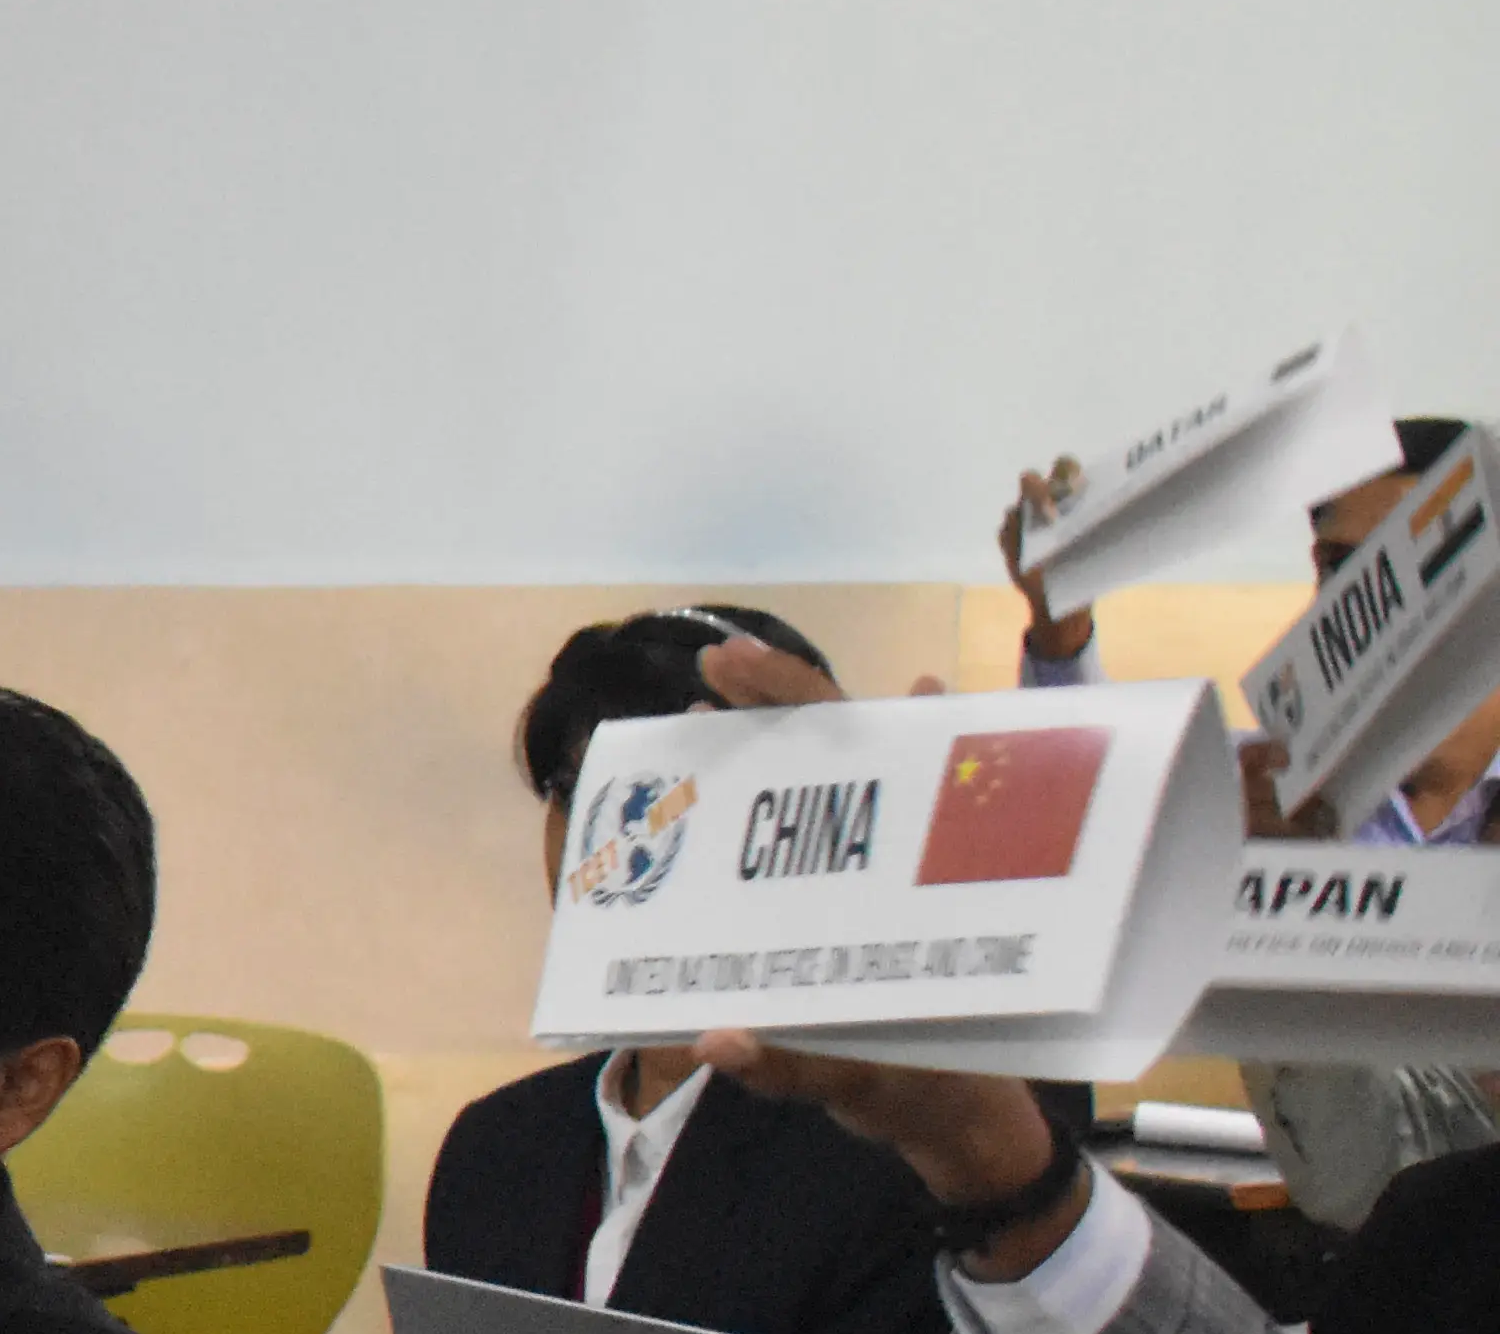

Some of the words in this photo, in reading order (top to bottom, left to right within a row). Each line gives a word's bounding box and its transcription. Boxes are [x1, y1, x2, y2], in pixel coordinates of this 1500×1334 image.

[1307, 544, 1406, 695] INDIA
[738, 778, 881, 882] CHINA
[1235, 869, 1407, 921] APAN
